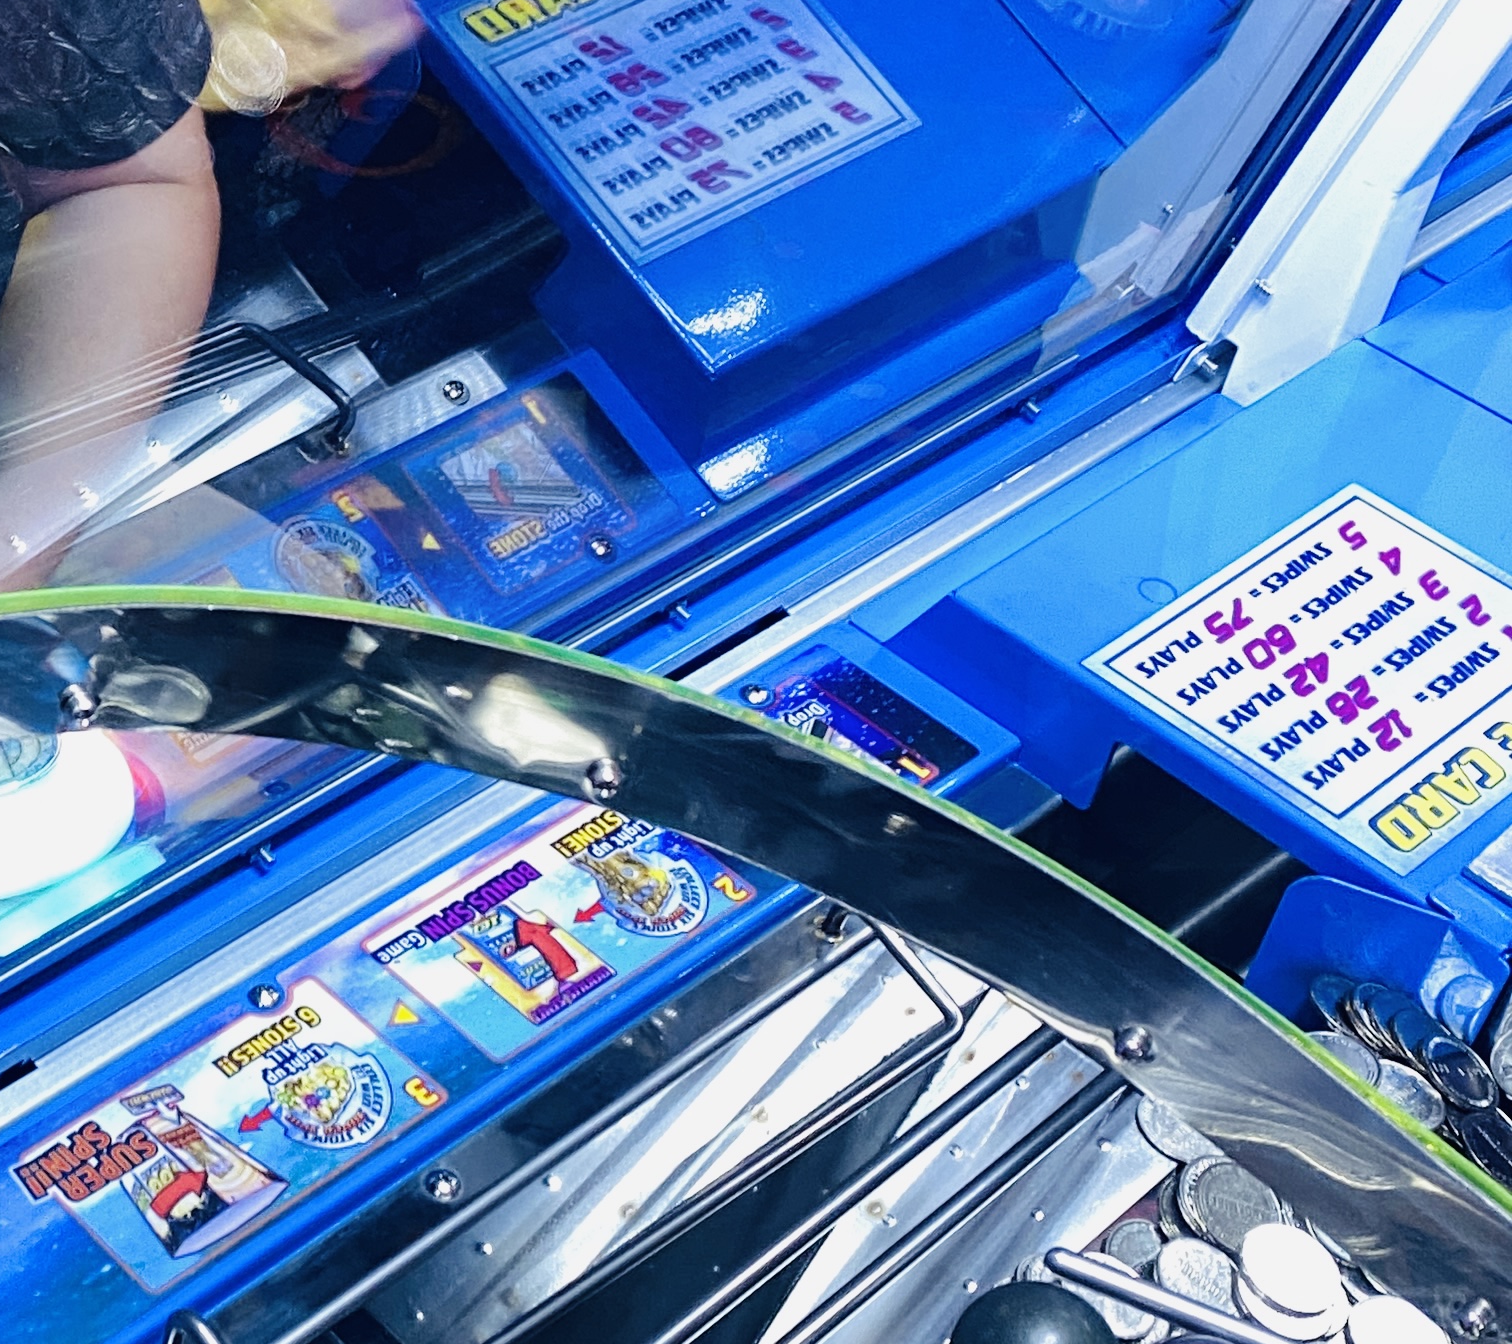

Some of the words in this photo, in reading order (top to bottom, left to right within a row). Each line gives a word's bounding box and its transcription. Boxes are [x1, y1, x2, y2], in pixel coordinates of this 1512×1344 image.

[1338, 520, 1368, 551] 5
[1260, 542, 1333, 594] SWIPES
[1377, 546, 1402, 577] 4
[1418, 569, 1450, 601] 3
[1301, 566, 1373, 620] SWIPES
[1457, 593, 1493, 627] 2
[1203, 597, 1254, 644] 75
[1342, 591, 1415, 646] SWIPES
[1134, 630, 1204, 679] PLAYS
[1242, 623, 1297, 670] 60
[1382, 616, 1457, 673] SWIPES
[1175, 656, 1245, 706] PLAYS
[1283, 651, 1330, 698] 42
[1424, 641, 1501, 700] SWIPES
[785, 700, 827, 727] Drop
[1216, 682, 1287, 735] PLAYS
[1324, 674, 1380, 726] 26
[1257, 709, 1329, 763] PLAYS
[1366, 708, 1413, 753] 12
[1300, 736, 1372, 791] PLAYS
[1367, 745, 1507, 854] CARD
[550, 808, 624, 859] STONE!
[590, 839, 614, 859] up
[611, 818, 654, 849] Light
[465, 859, 543, 914] BONUS
[712, 874, 748, 902] 2
[416, 899, 476, 944] SPIN
[371, 928, 428, 965] Game
[295, 1006, 322, 1028] 6
[263, 1037, 301, 1067] ALL
[287, 1042, 327, 1077] Light
[264, 1066, 289, 1086] up
[403, 1075, 441, 1107] 3
[18, 1120, 112, 1200] SPIN!!
[58, 1129, 159, 1202] SUPER
